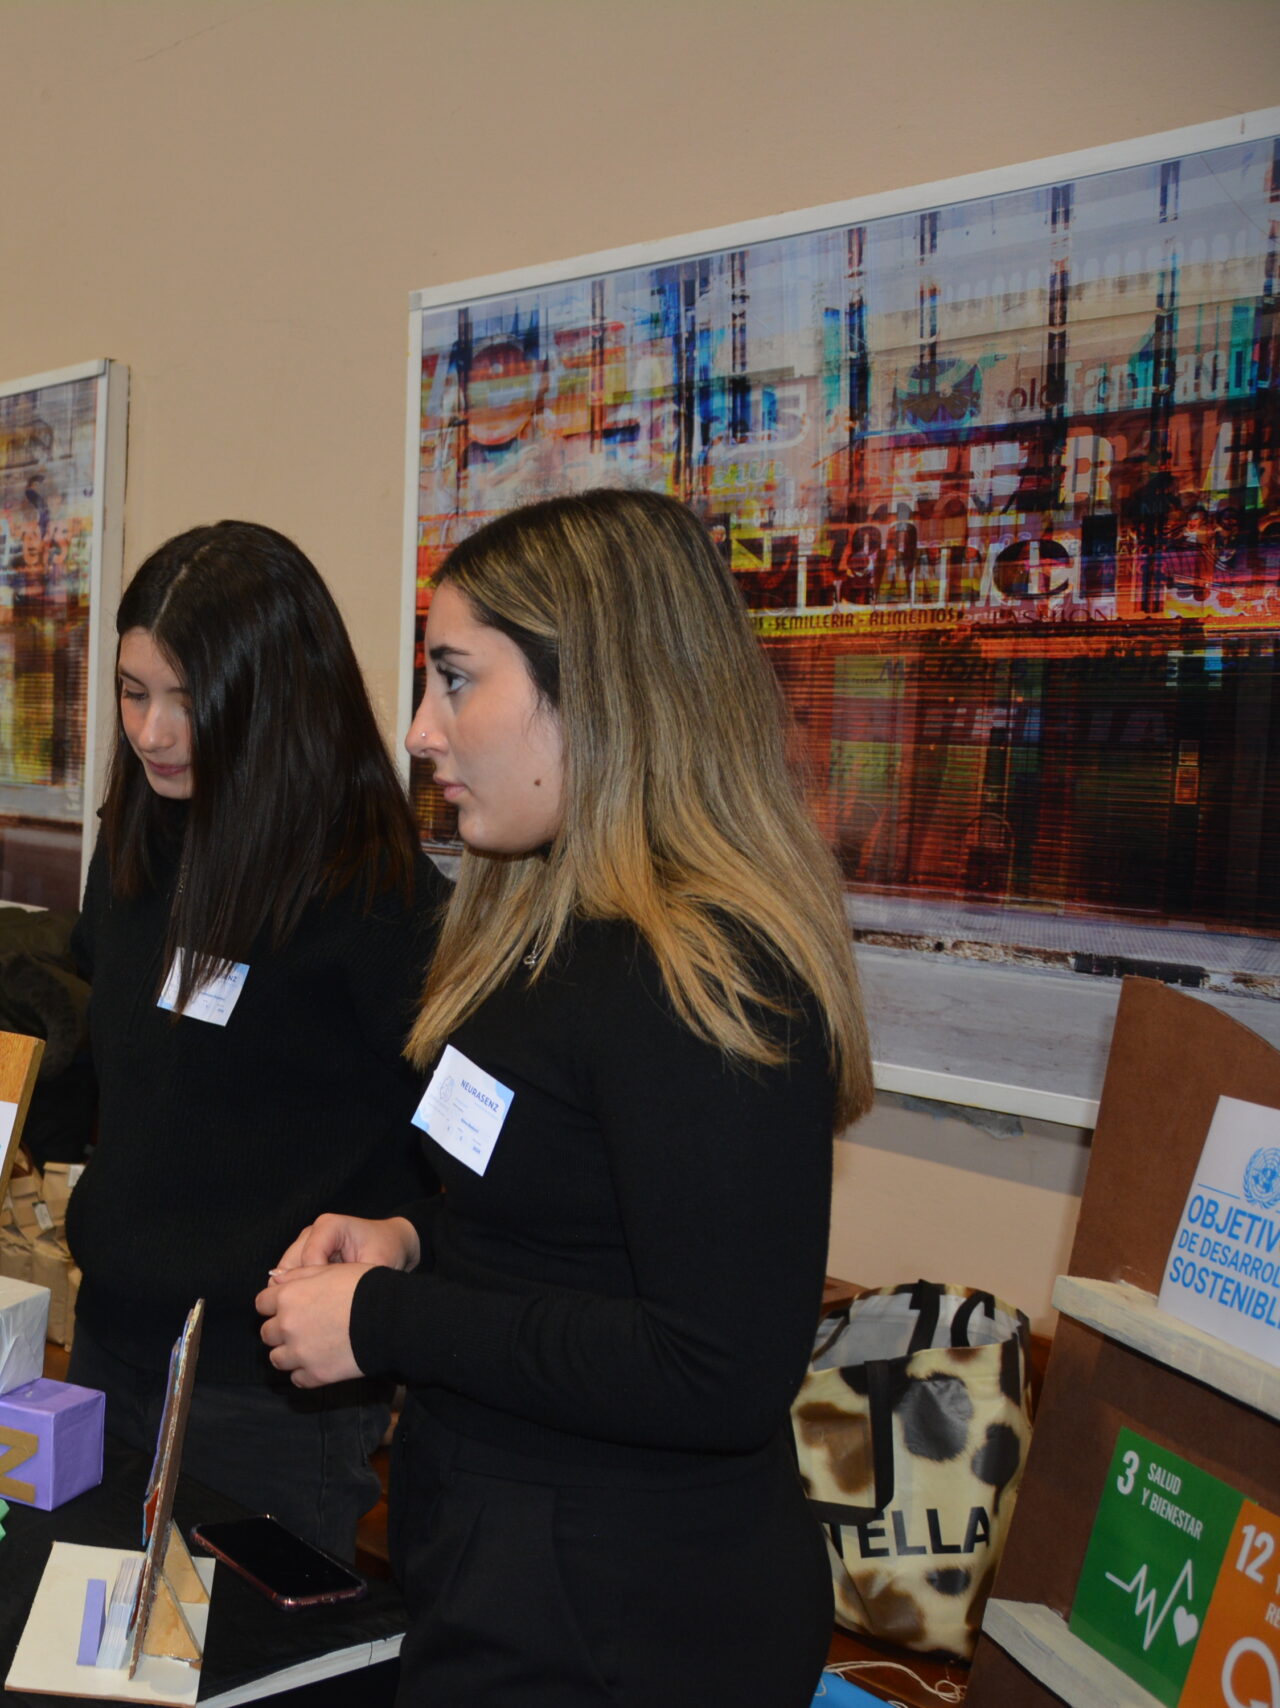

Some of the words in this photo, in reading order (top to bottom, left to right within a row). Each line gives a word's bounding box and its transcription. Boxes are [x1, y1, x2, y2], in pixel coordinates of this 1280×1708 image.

[868, 607, 955, 627] ALIMENTOS
[460, 1079, 500, 1114] NEURASENZ
[1178, 1228, 1200, 1254] DE
[1169, 1255, 1280, 1331] SOSTENIBL
[1117, 1450, 1140, 1495] 3
[1147, 1462, 1182, 1496] SALUD
[1141, 1487, 1150, 1506] Y
[1149, 1494, 1204, 1541] BIENESTAR
[1236, 1524, 1275, 1584] 12
